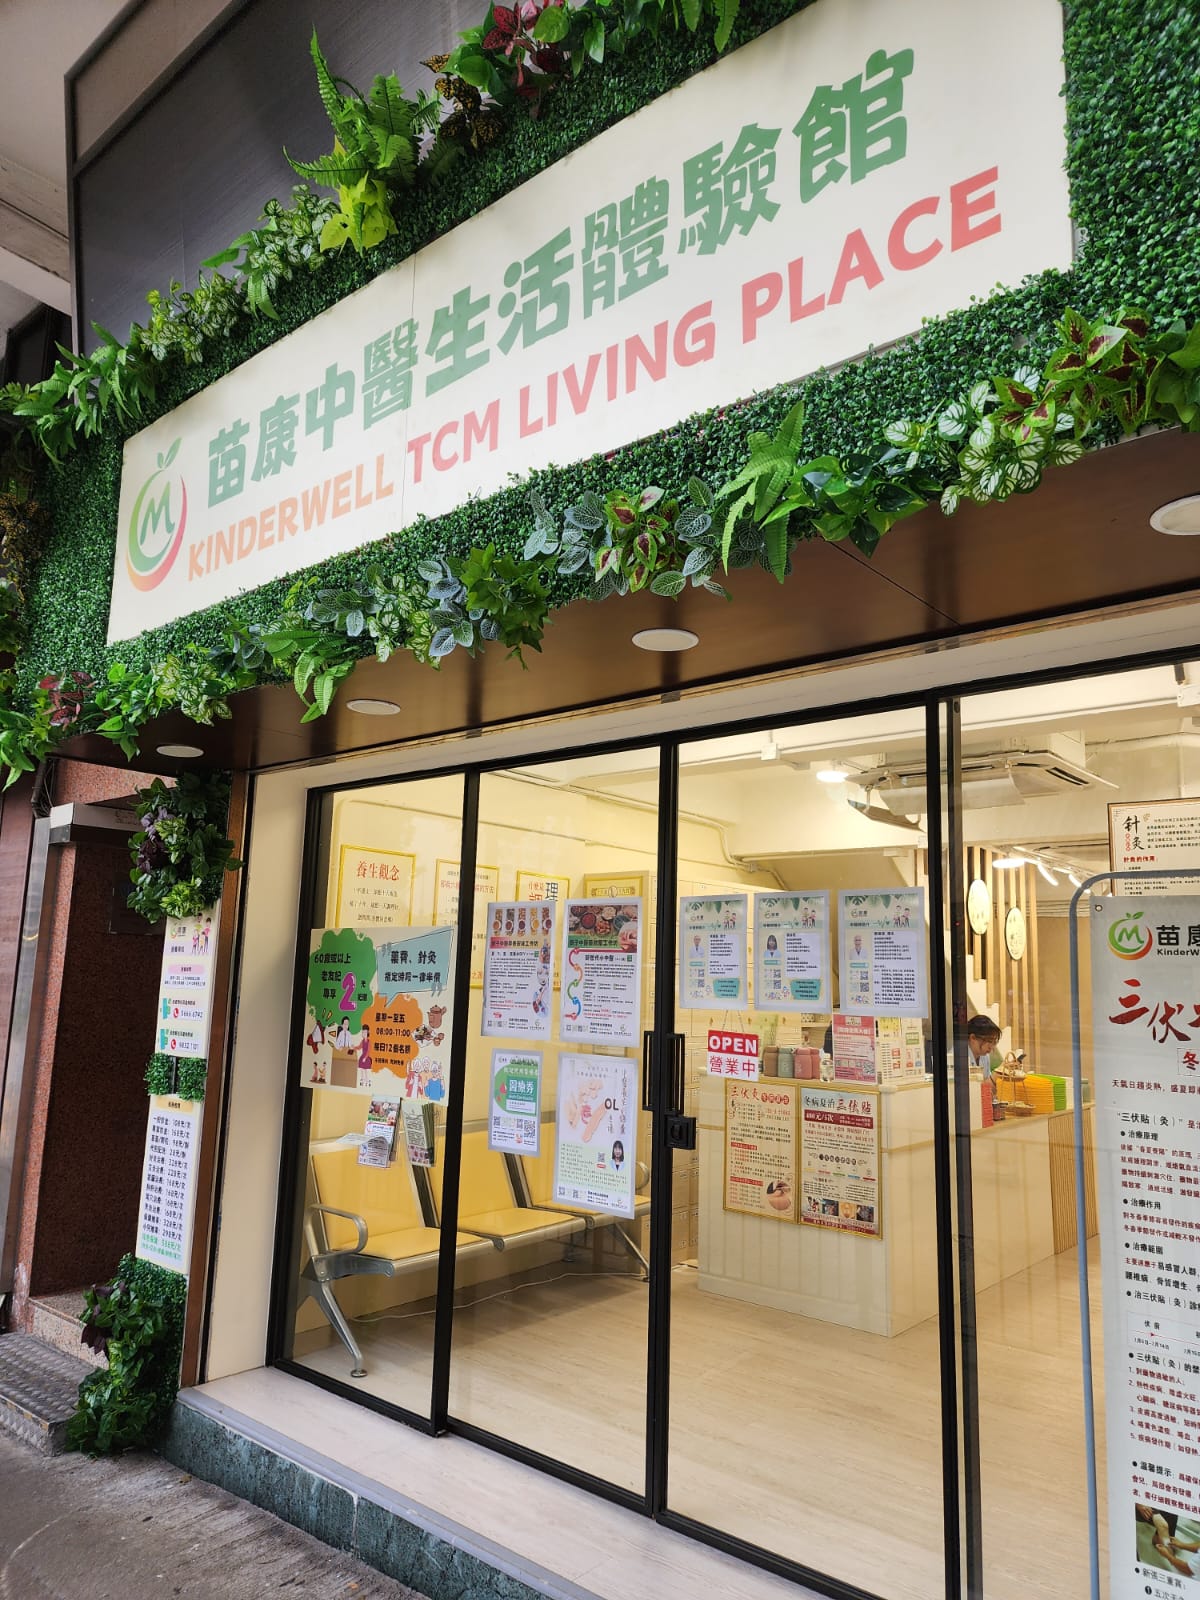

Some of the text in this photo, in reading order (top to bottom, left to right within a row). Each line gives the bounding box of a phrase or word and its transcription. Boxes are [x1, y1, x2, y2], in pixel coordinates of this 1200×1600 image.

[207, 48, 915, 508] 苗康中醫生活體驗館
[189, 166, 1002, 581] KINDERWELL TCM LIVING PLACE
[357, 861, 400, 881] 養生觀念
[339, 972, 357, 1011] 2
[709, 1035, 757, 1054] OPEN
[710, 1056, 755, 1078] 營業中
[604, 1098, 619, 1110] OL
